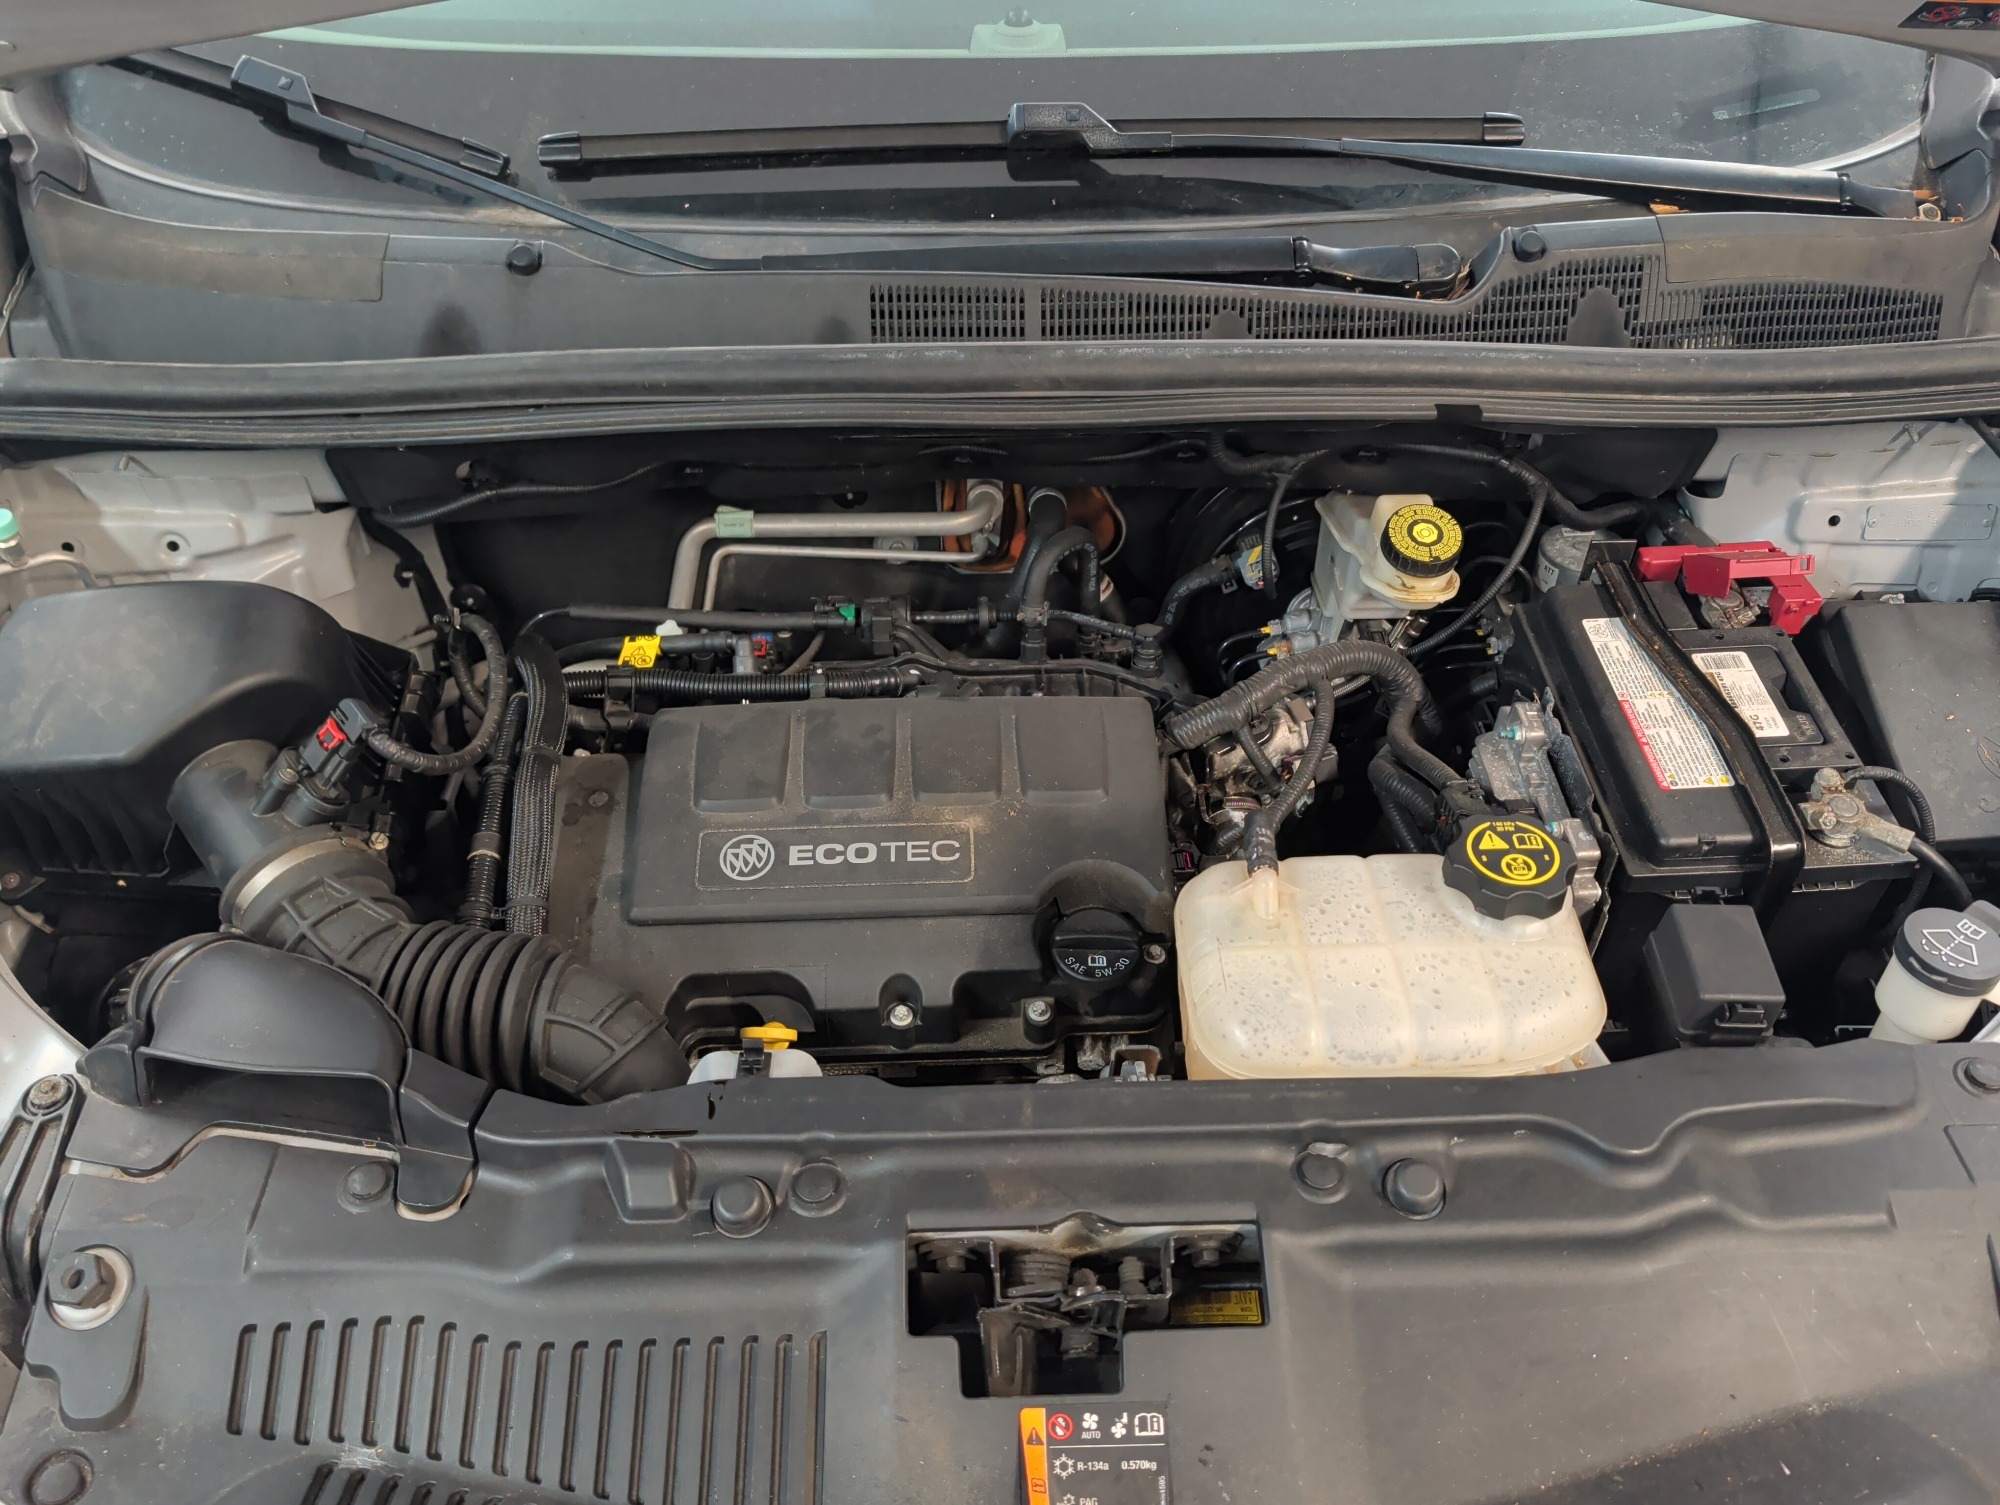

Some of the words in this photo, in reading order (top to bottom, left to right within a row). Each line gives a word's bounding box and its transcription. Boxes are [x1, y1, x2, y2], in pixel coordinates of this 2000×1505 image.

[1750, 714, 1765, 731] 47G
[788, 840, 961, 866] ECOTEC
[1065, 956, 1087, 975] SAE
[1094, 957, 1130, 978] 5W-30
[1081, 1430, 1101, 1439] AUTO
[1077, 1461, 1109, 1471] R-134a
[1121, 1460, 1157, 1471] 0.570kg
[1079, 1497, 1098, 1505] PAG
